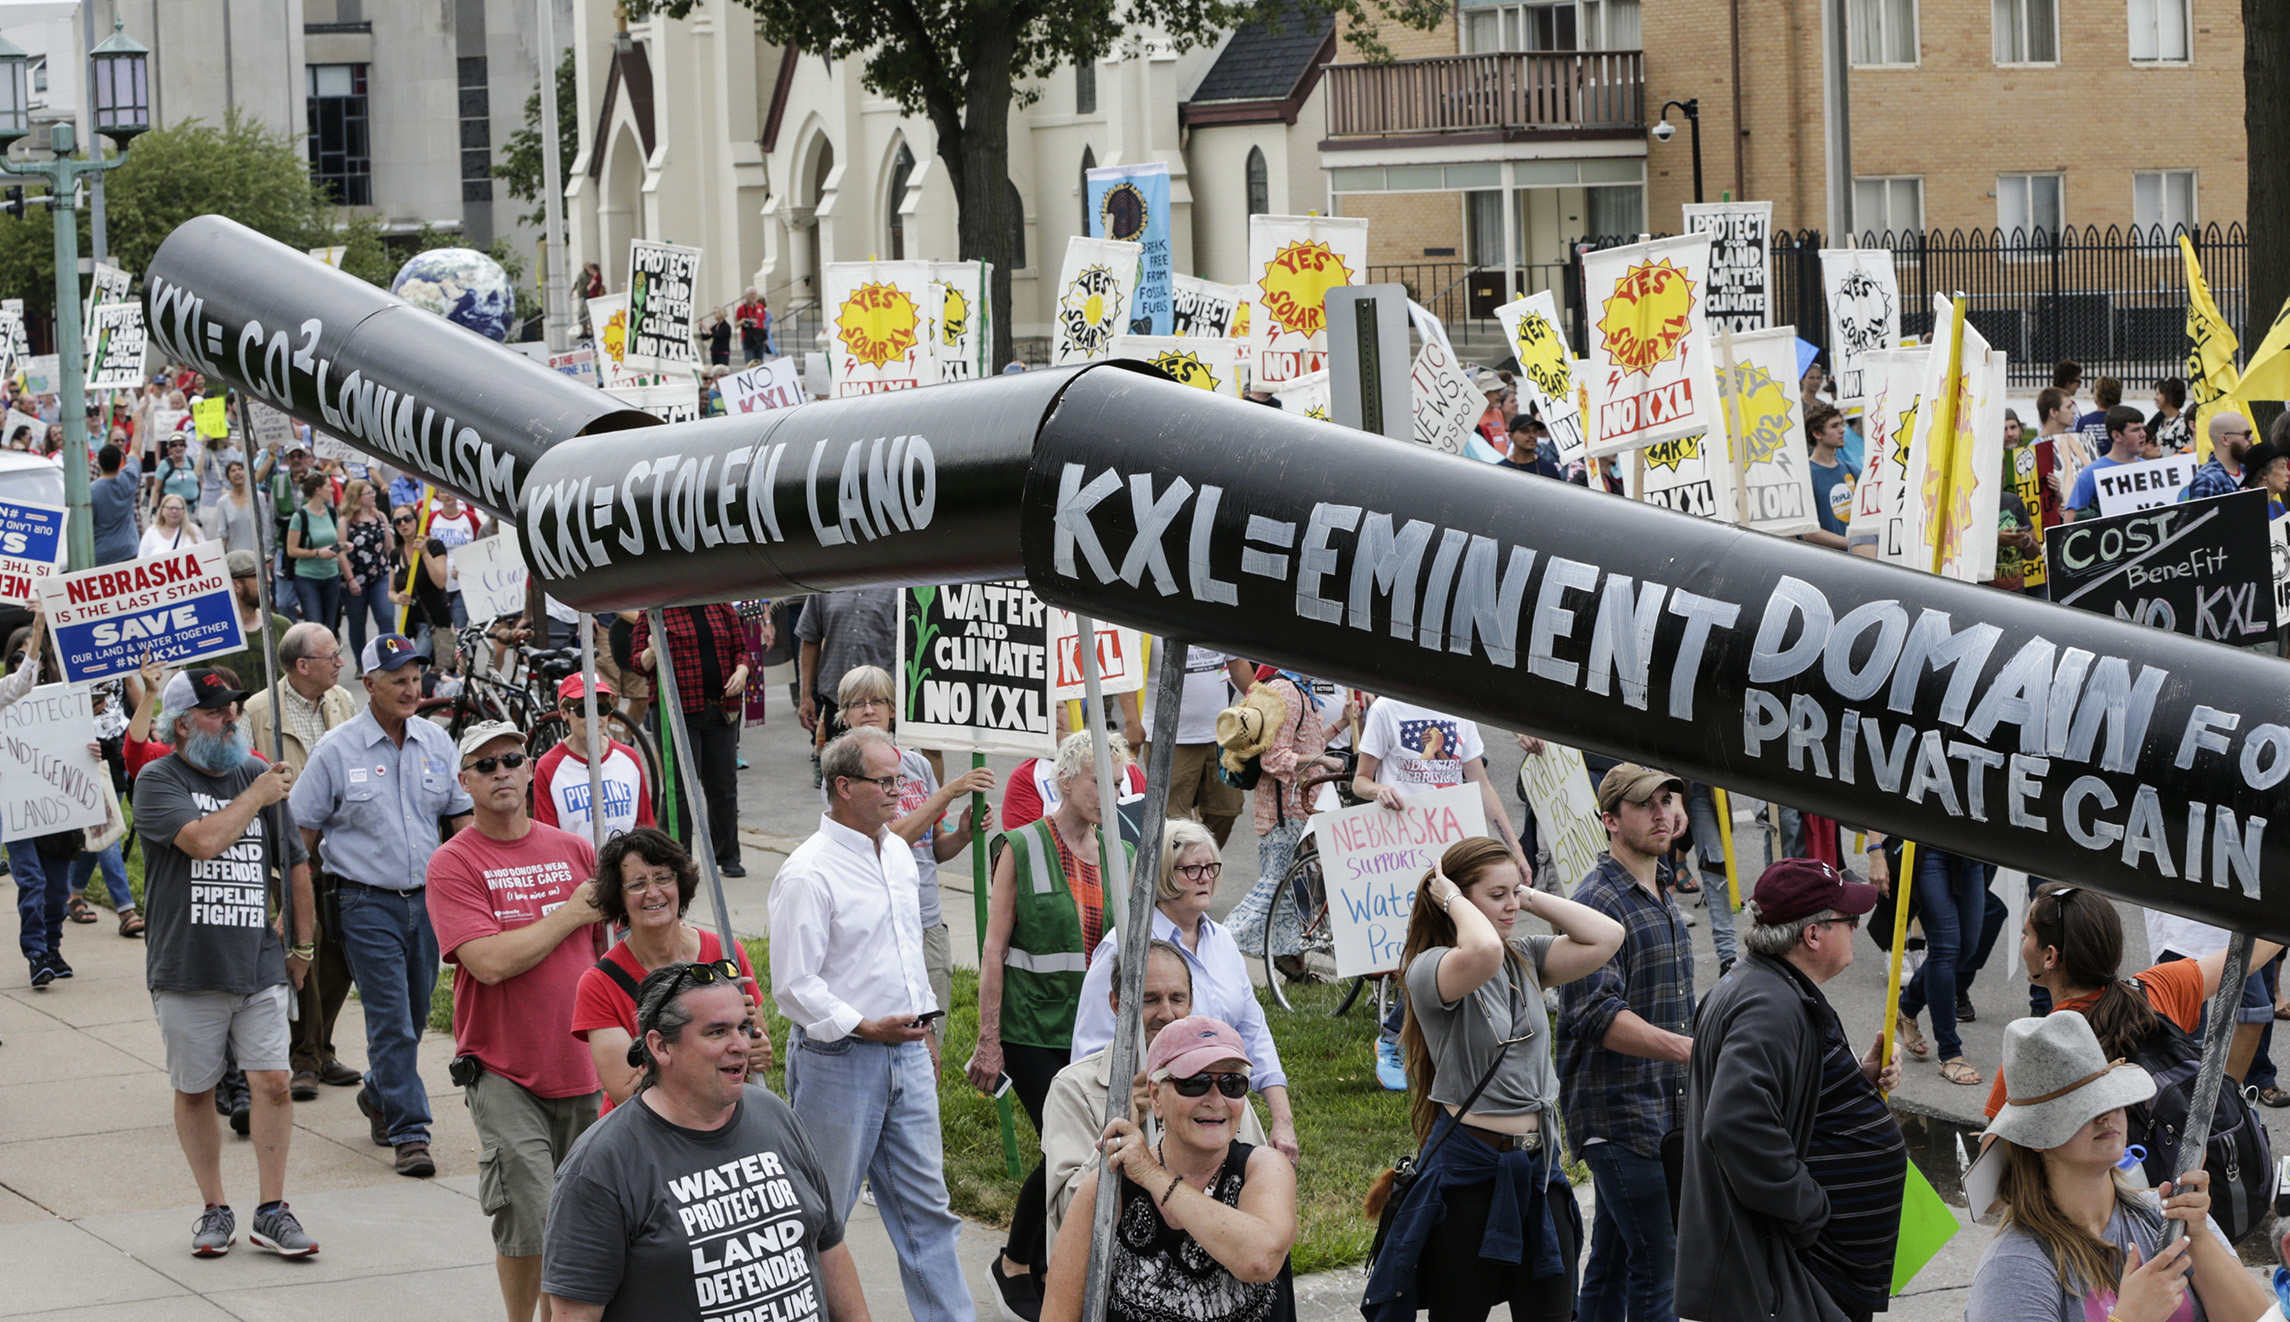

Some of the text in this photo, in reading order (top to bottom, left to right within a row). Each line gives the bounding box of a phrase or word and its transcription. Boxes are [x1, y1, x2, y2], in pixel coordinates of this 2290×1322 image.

[1693, 213, 1765, 241] PROTECT
[1724, 239, 1748, 248] OUR
[635, 248, 695, 279] PROTECT
[1149, 255, 1169, 267] FREE
[1277, 248, 1330, 276] YES
[1079, 271, 1111, 297] YES
[1146, 270, 1168, 283] FROM
[1618, 269, 1672, 305] YES
[1708, 266, 1764, 287] WATER
[1720, 286, 1745, 294] AND
[1843, 277, 1873, 302] YES
[646, 295, 690, 319] WATER
[852, 289, 898, 313] YES
[1139, 286, 1168, 300] FOSSIL
[1142, 301, 1168, 315] FUELS
[1172, 289, 1232, 325] PROTECT
[1706, 294, 1765, 312] CLIMATE
[1269, 290, 1319, 329] SOLAR
[642, 317, 688, 340] CLIMATE
[1068, 309, 1098, 348] SOLAR
[1521, 319, 1545, 346] YES
[1730, 315, 1764, 335] KXL
[1866, 318, 1884, 341] XL
[637, 334, 689, 362] NO KXL
[845, 326, 911, 361] SOLAR XL
[1611, 315, 1685, 367] SOLAR XL
[97, 367, 139, 383] NO KXL
[103, 355, 141, 368] CLIMATE
[581, 363, 592, 374] XL
[943, 361, 969, 382] XL
[1159, 359, 1198, 383] ES
[1264, 352, 1299, 382] NO
[736, 366, 774, 392] NO
[1530, 363, 1567, 395] SOLAR
[1602, 397, 1637, 440] NO
[1638, 380, 1694, 429] KXL
[1648, 436, 1682, 461] LAR
[806, 433, 937, 548] LAND
[2100, 466, 2182, 498] THERE
[1668, 483, 1716, 518] KXL
[6, 520, 54, 536] OUR LAND
[2062, 510, 2180, 570] COST
[1, 560, 50, 577] IS THE
[66, 553, 203, 605] NEBRASKA
[55, 576, 224, 623] IS THE LAST STAND
[940, 584, 1047, 628] WATER
[2114, 581, 2269, 641] NO KXL
[91, 603, 199, 647] SAVE
[964, 621, 1008, 640] AND
[71, 621, 230, 665] OUR LAND & WATER TOGETHER
[115, 644, 192, 669] #NOKXL
[934, 636, 1046, 680] CLIMATE
[1748, 574, 2169, 775] DOMAIN
[4, 691, 88, 729] ROTECT
[923, 680, 1049, 733] NO KXL
[0, 734, 100, 811] NDIGENOUS
[565, 780, 630, 811] PIPINE
[1743, 687, 2269, 901] PRIVATE GAIN
[9, 795, 71, 833] LANDS
[1550, 788, 1579, 835] FOR
[1331, 805, 1466, 856] NEBRASKA
[191, 858, 264, 883] DEFENDER
[509, 864, 544, 877] DONORS
[544, 861, 569, 872] WEAR
[537, 870, 573, 885] CAPES
[1346, 848, 1435, 880] SUPPORTS
[191, 885, 265, 907] PIPELINE
[1340, 881, 1415, 924] Wate
[191, 903, 265, 928] FIGHTER
[668, 1151, 785, 1204] WATER
[678, 1178, 800, 1237] PROTECTOR
[691, 1219, 806, 1275] LAND
[695, 1246, 811, 1308] DEFENDER
